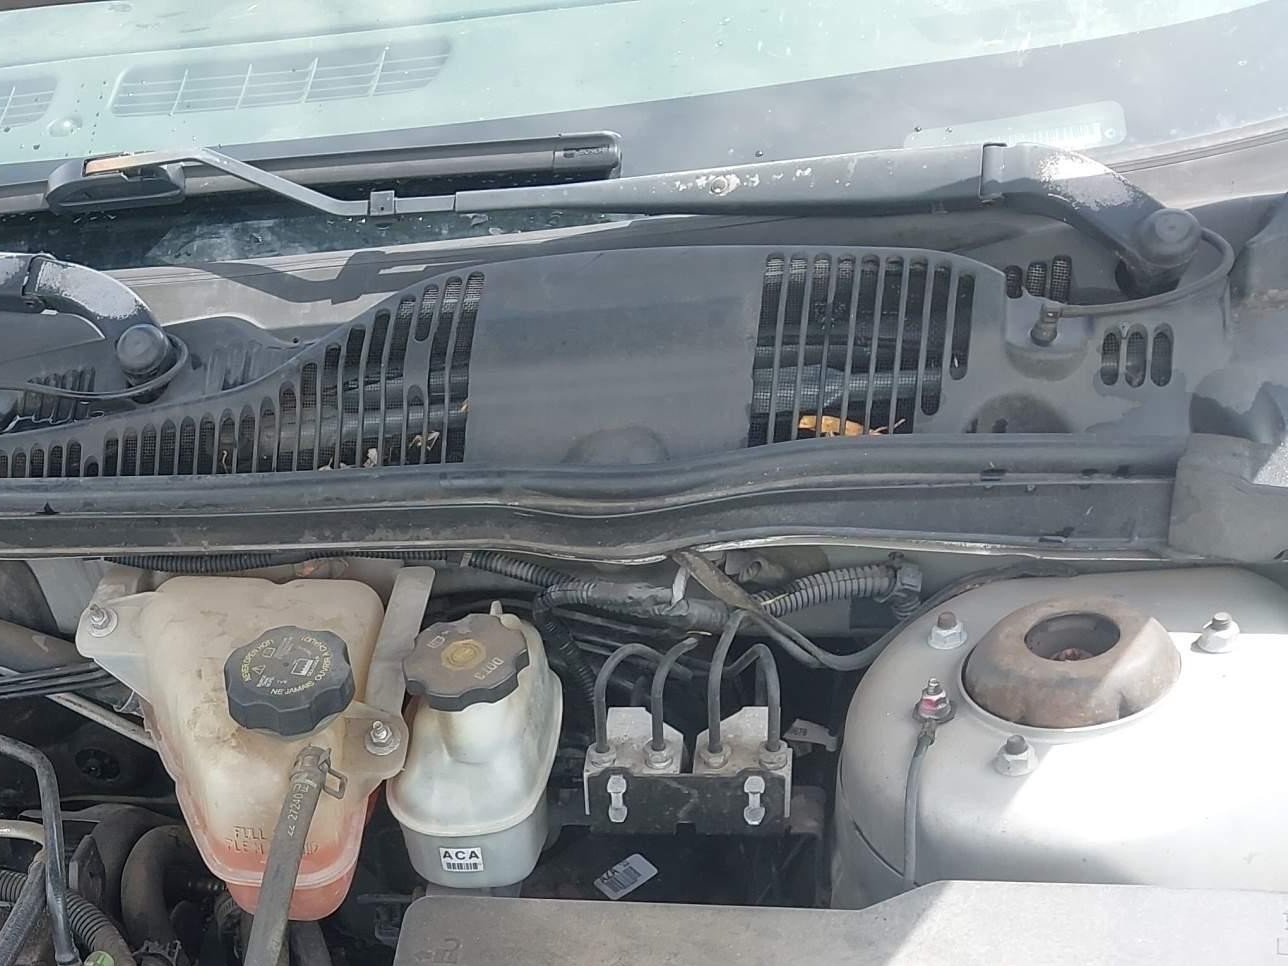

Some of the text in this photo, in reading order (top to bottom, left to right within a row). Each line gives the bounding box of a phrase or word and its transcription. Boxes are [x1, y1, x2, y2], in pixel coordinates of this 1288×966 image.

[284, 680, 315, 695] JAMAIS
[233, 825, 268, 841] FULL
[442, 850, 480, 860] ACA
